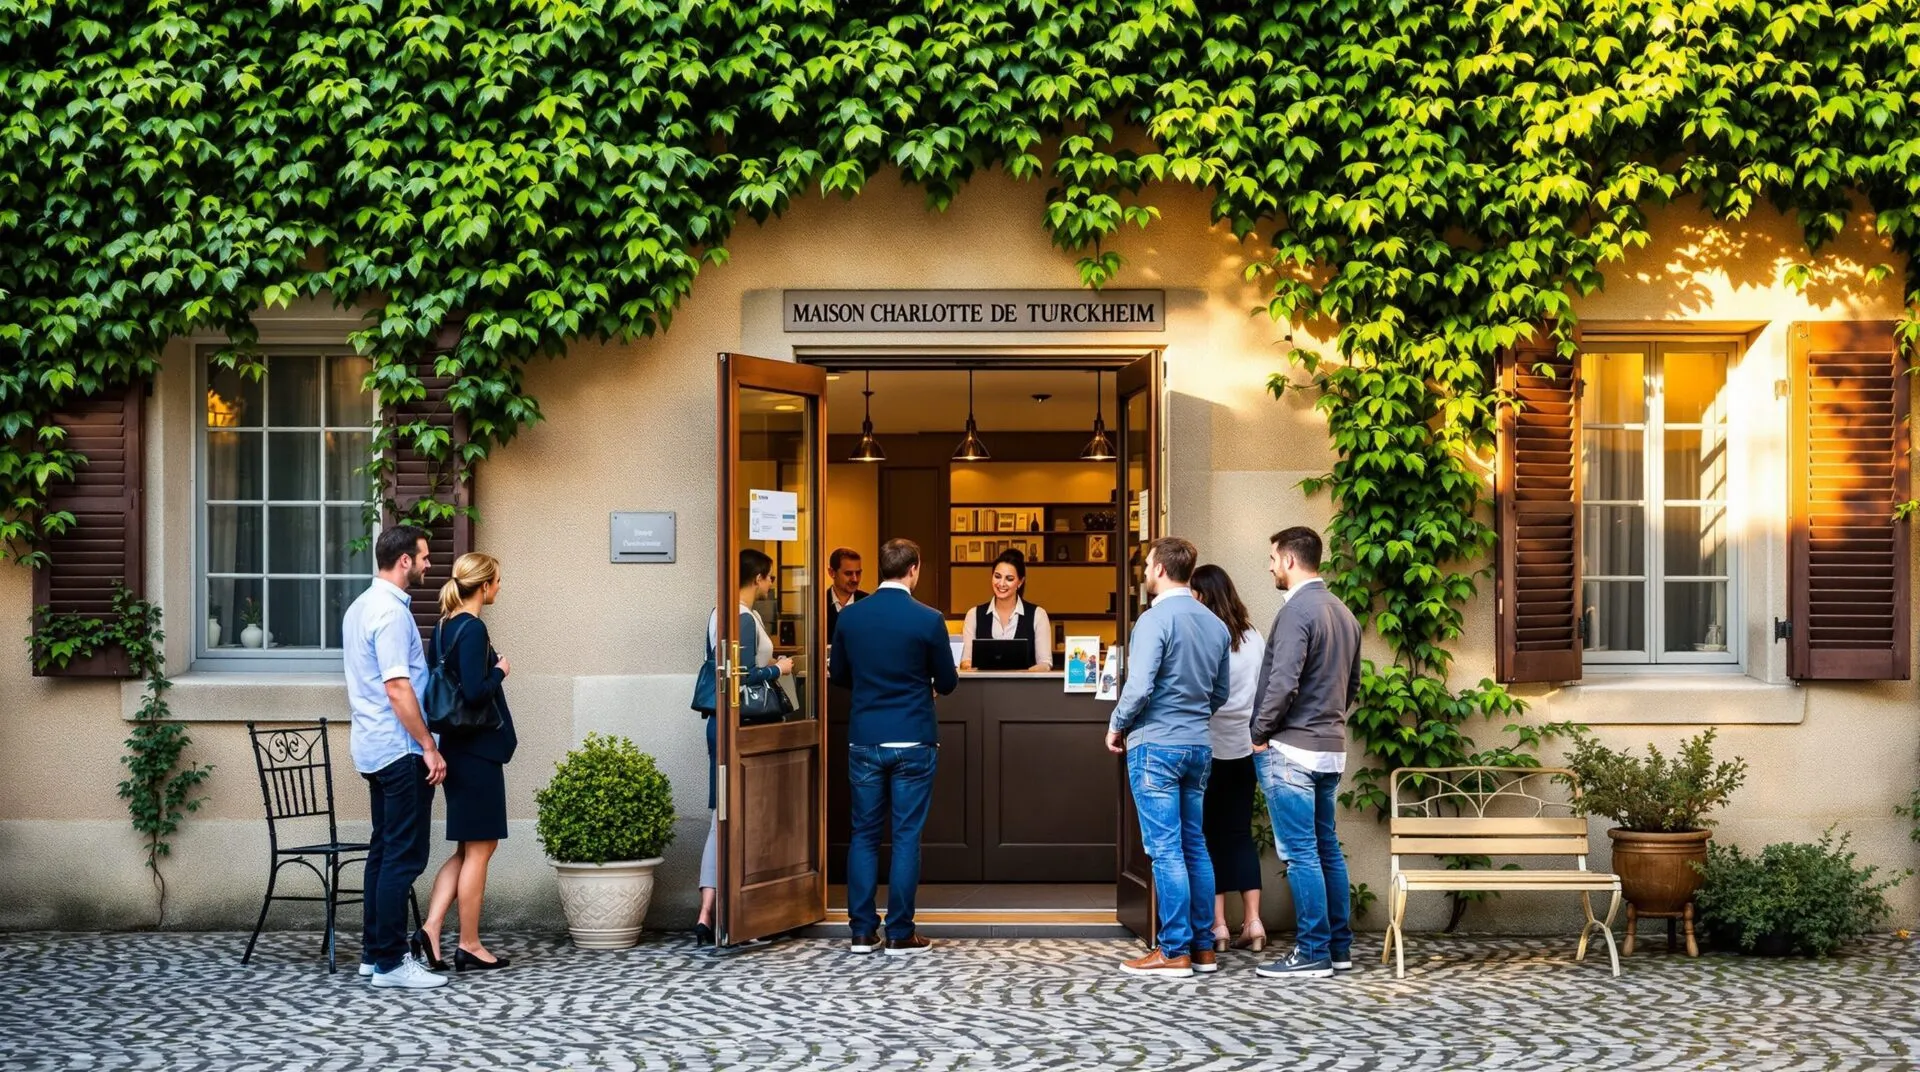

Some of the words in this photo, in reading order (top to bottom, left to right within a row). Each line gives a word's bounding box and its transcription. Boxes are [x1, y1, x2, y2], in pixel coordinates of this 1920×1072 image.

[793, 303, 865, 323] MAISON
[870, 303, 983, 323] CHARLOTTE
[990, 303, 1018, 323] DE
